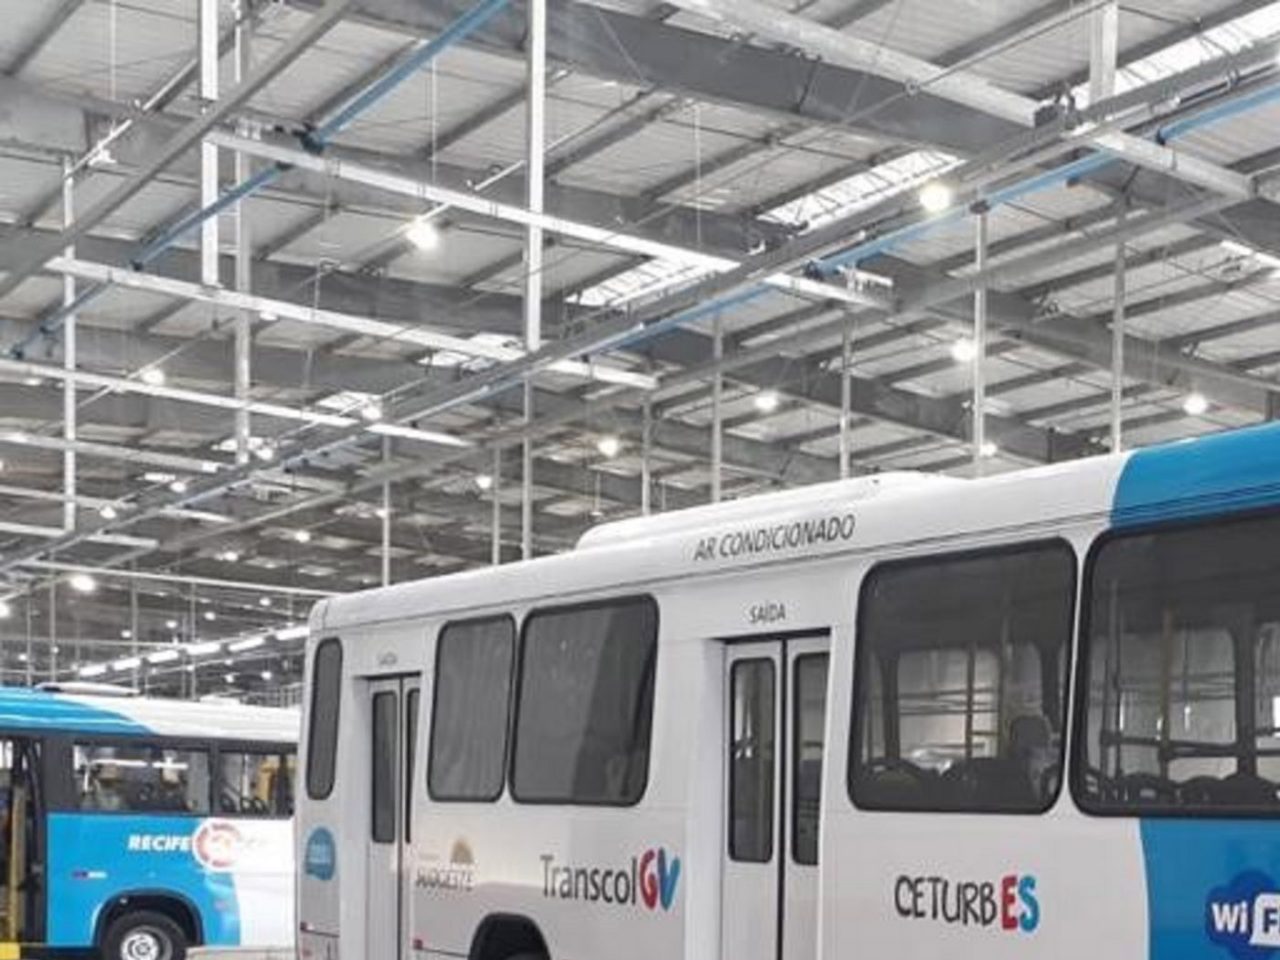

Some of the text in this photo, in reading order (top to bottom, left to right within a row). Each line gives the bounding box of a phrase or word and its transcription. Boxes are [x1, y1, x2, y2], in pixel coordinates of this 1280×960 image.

[694, 514, 855, 561] AR CONDICIONADO
[127, 833, 191, 852] RECIFE
